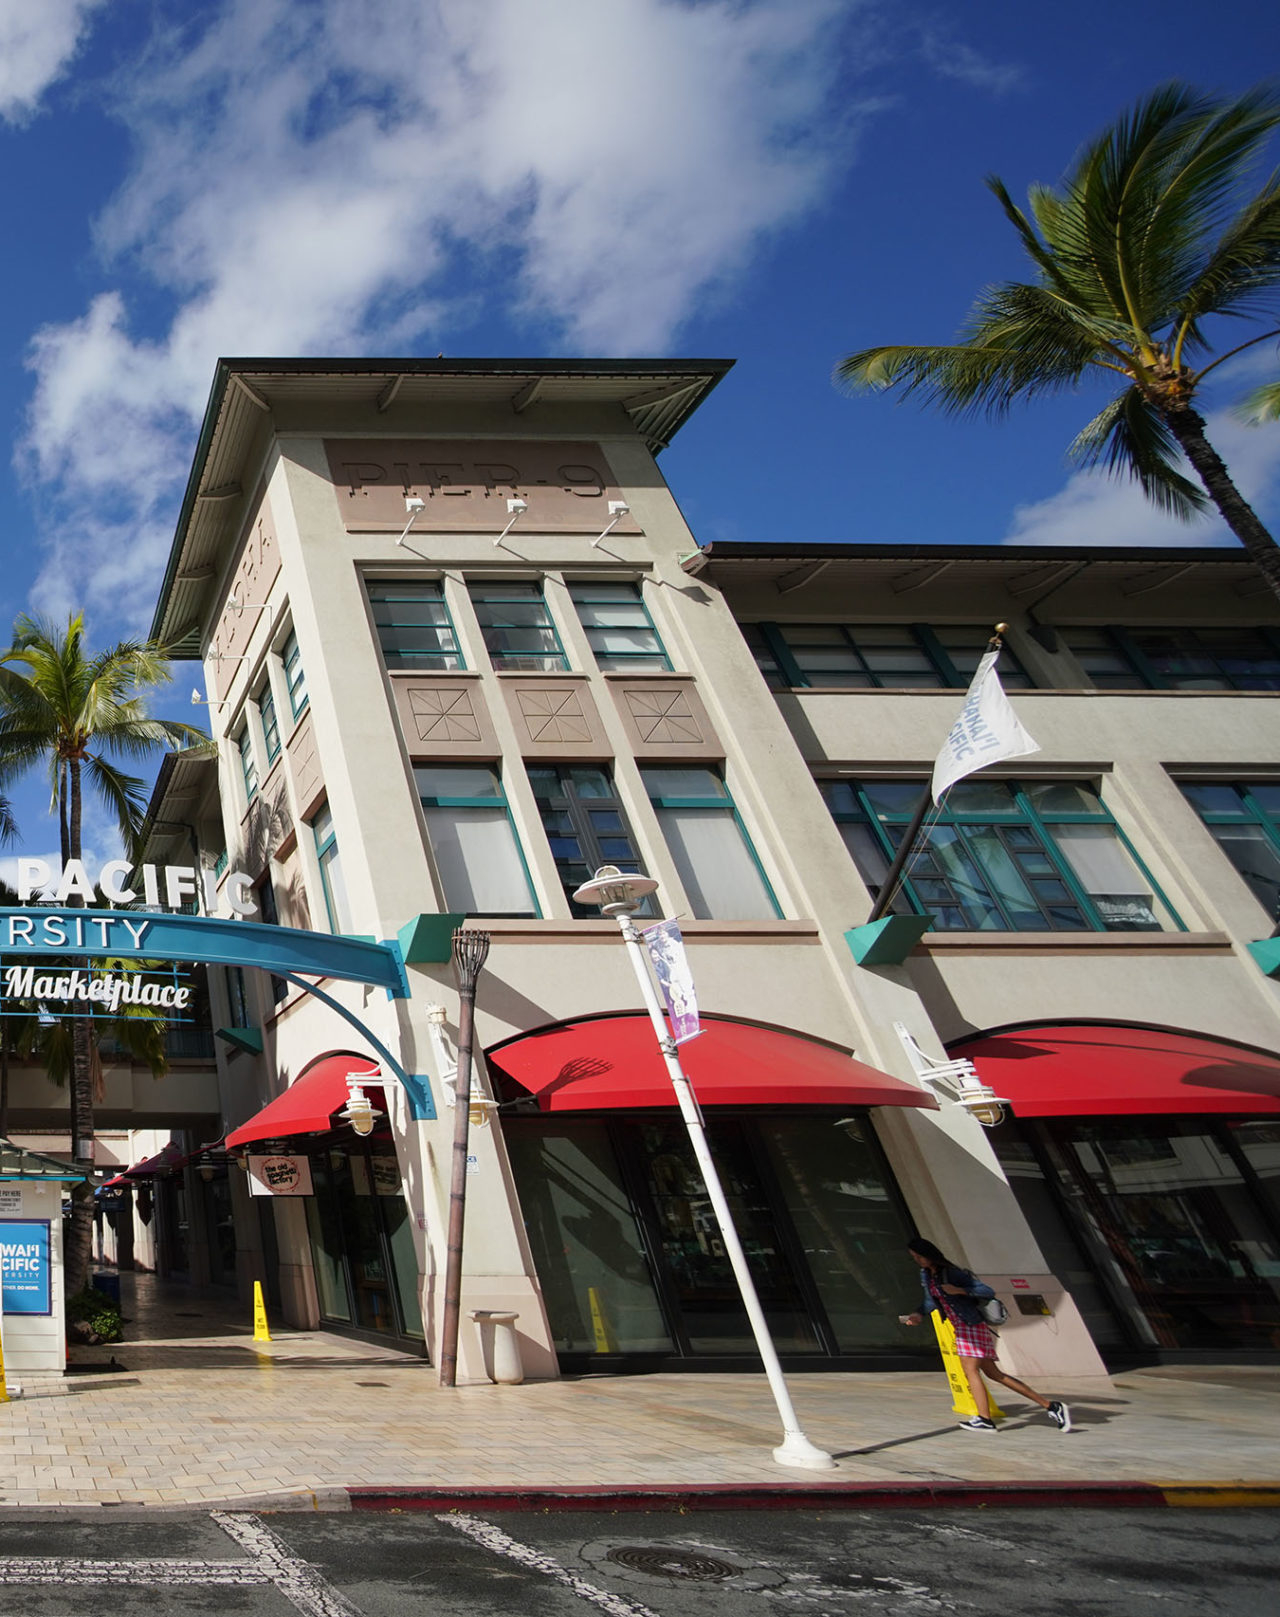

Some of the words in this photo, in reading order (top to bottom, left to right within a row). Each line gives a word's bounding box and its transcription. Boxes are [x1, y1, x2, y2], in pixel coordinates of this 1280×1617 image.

[18, 858, 259, 916] PACIFIC
[5, 965, 190, 1012] Marketplace
[265, 1164, 276, 1173] the
[277, 1163, 288, 1172] old
[267, 1167, 297, 1179] spaghetti
[270, 1175, 293, 1185] factory
